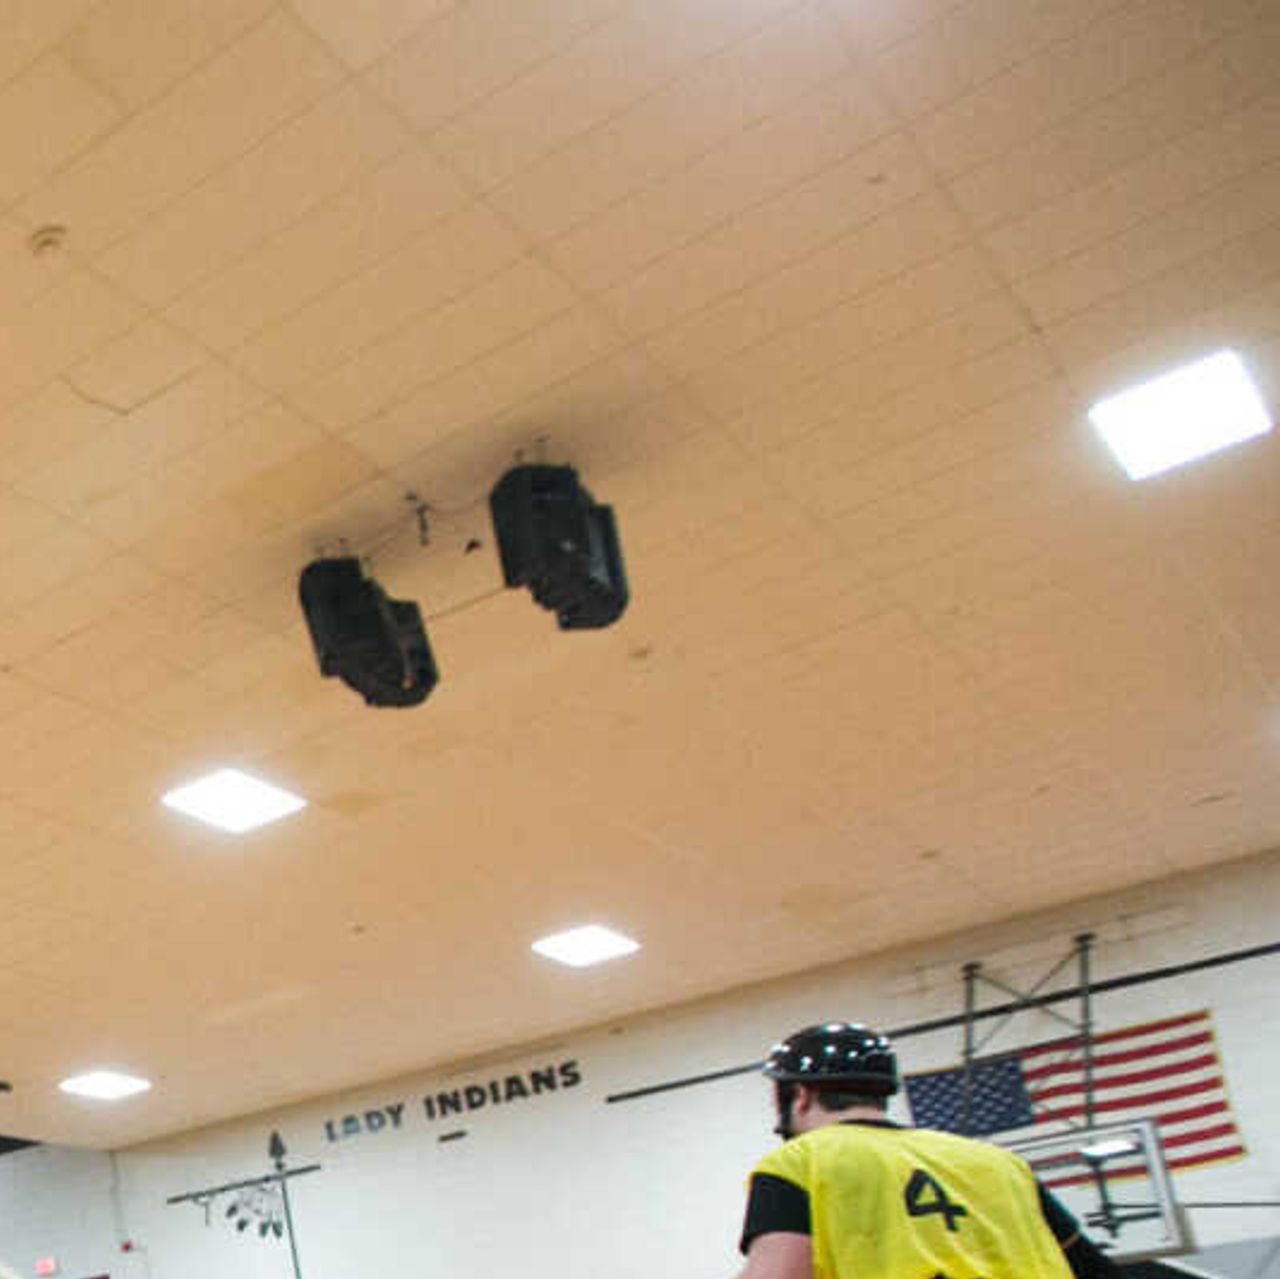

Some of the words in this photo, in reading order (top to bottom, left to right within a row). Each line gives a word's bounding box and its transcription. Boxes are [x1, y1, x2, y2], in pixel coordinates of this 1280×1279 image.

[324, 1102, 405, 1143] LADY
[423, 1059, 582, 1121] INDIANS
[903, 1168, 968, 1233] 4
